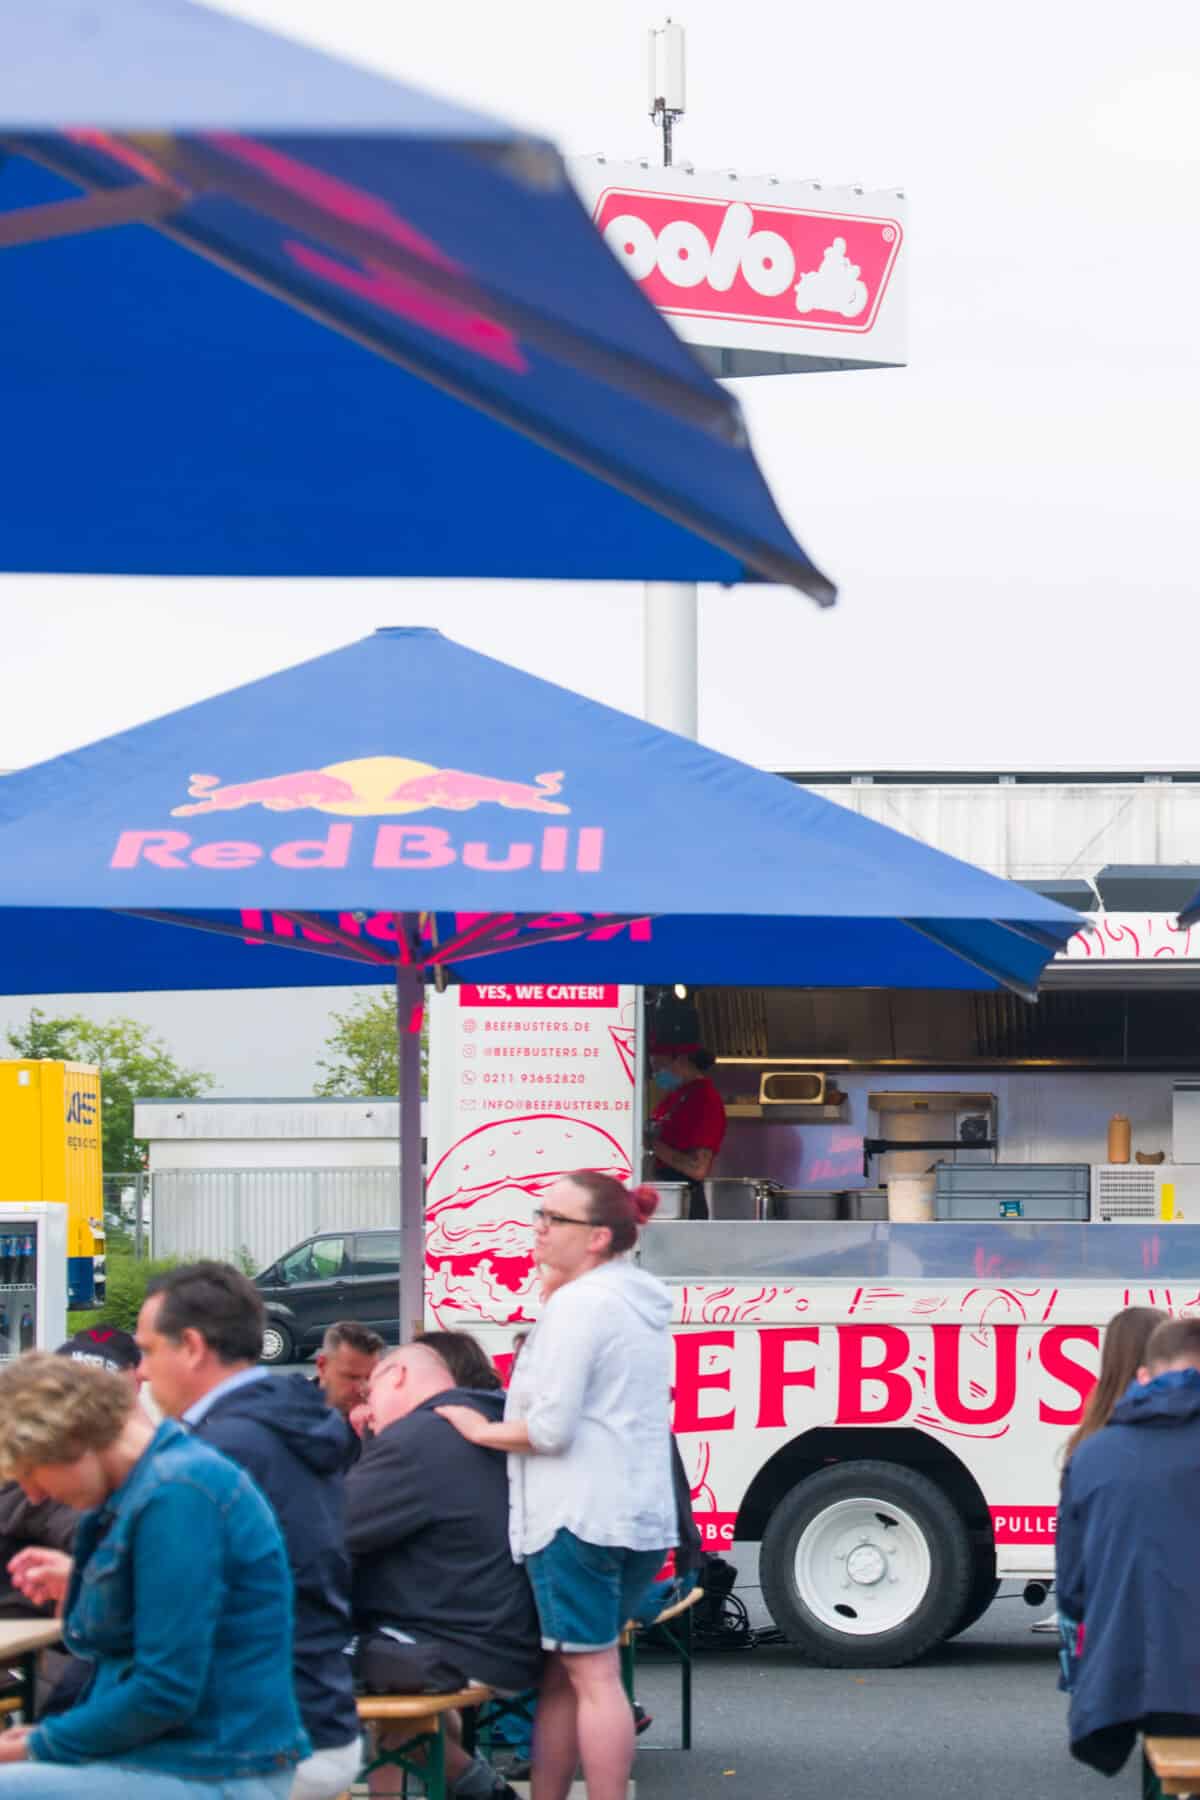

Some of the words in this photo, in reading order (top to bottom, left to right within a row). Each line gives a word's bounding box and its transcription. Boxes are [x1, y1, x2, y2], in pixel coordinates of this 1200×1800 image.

[110, 823, 352, 869] Red
[372, 825, 605, 872] Bull
[476, 984, 512, 1001] YES,
[515, 985, 544, 1000] WE
[546, 985, 604, 1001] CATER!
[484, 1021, 591, 1033] BEEFBUSTERS.DE
[483, 1047, 600, 1058] @BEEFBUSTERS.DE
[482, 1073, 514, 1085] 0211
[482, 1099, 632, 1111] INFO@BEEFBUSTERS.DE
[994, 1516, 1057, 1533] PULLE
